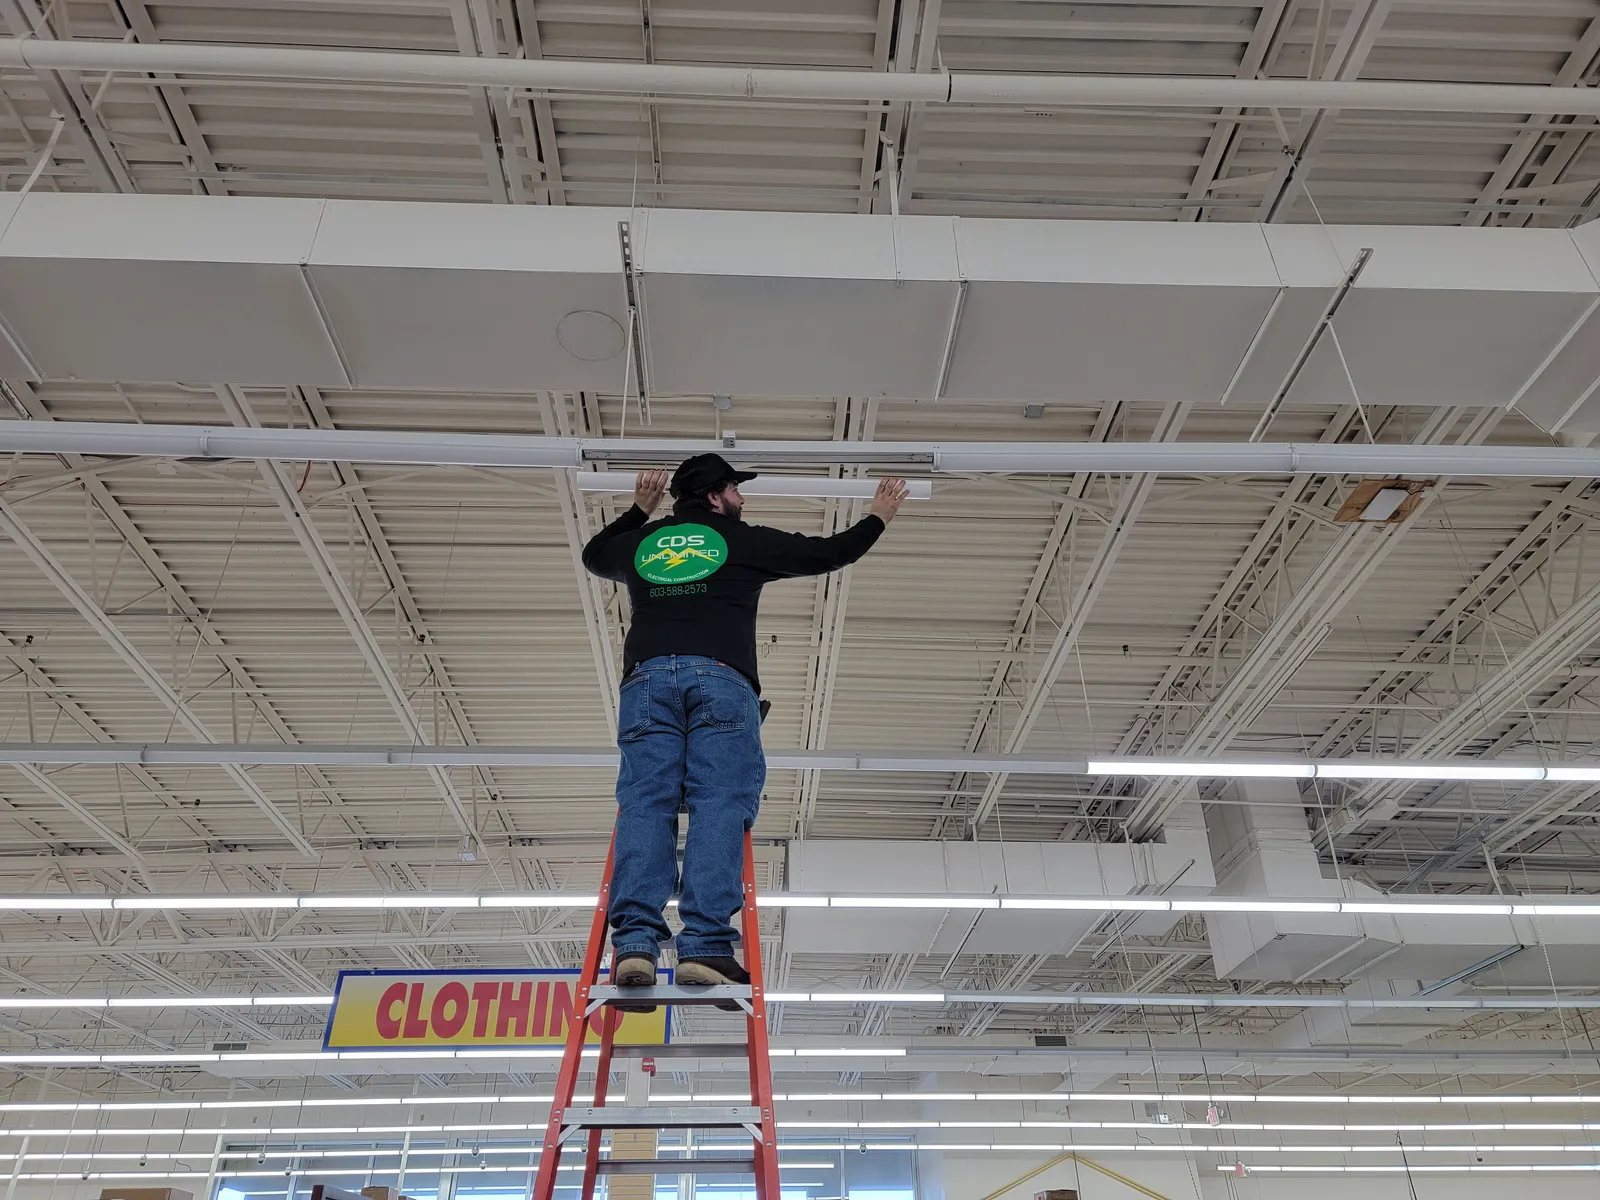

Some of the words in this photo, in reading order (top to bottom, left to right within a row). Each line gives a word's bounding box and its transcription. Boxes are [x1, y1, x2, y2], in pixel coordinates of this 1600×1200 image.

[656, 535, 705, 548] CDS
[647, 572, 673, 582] ELECTRICAL
[673, 568, 710, 582] CONSTRUCTION
[649, 583, 708, 598] 603-588-2573
